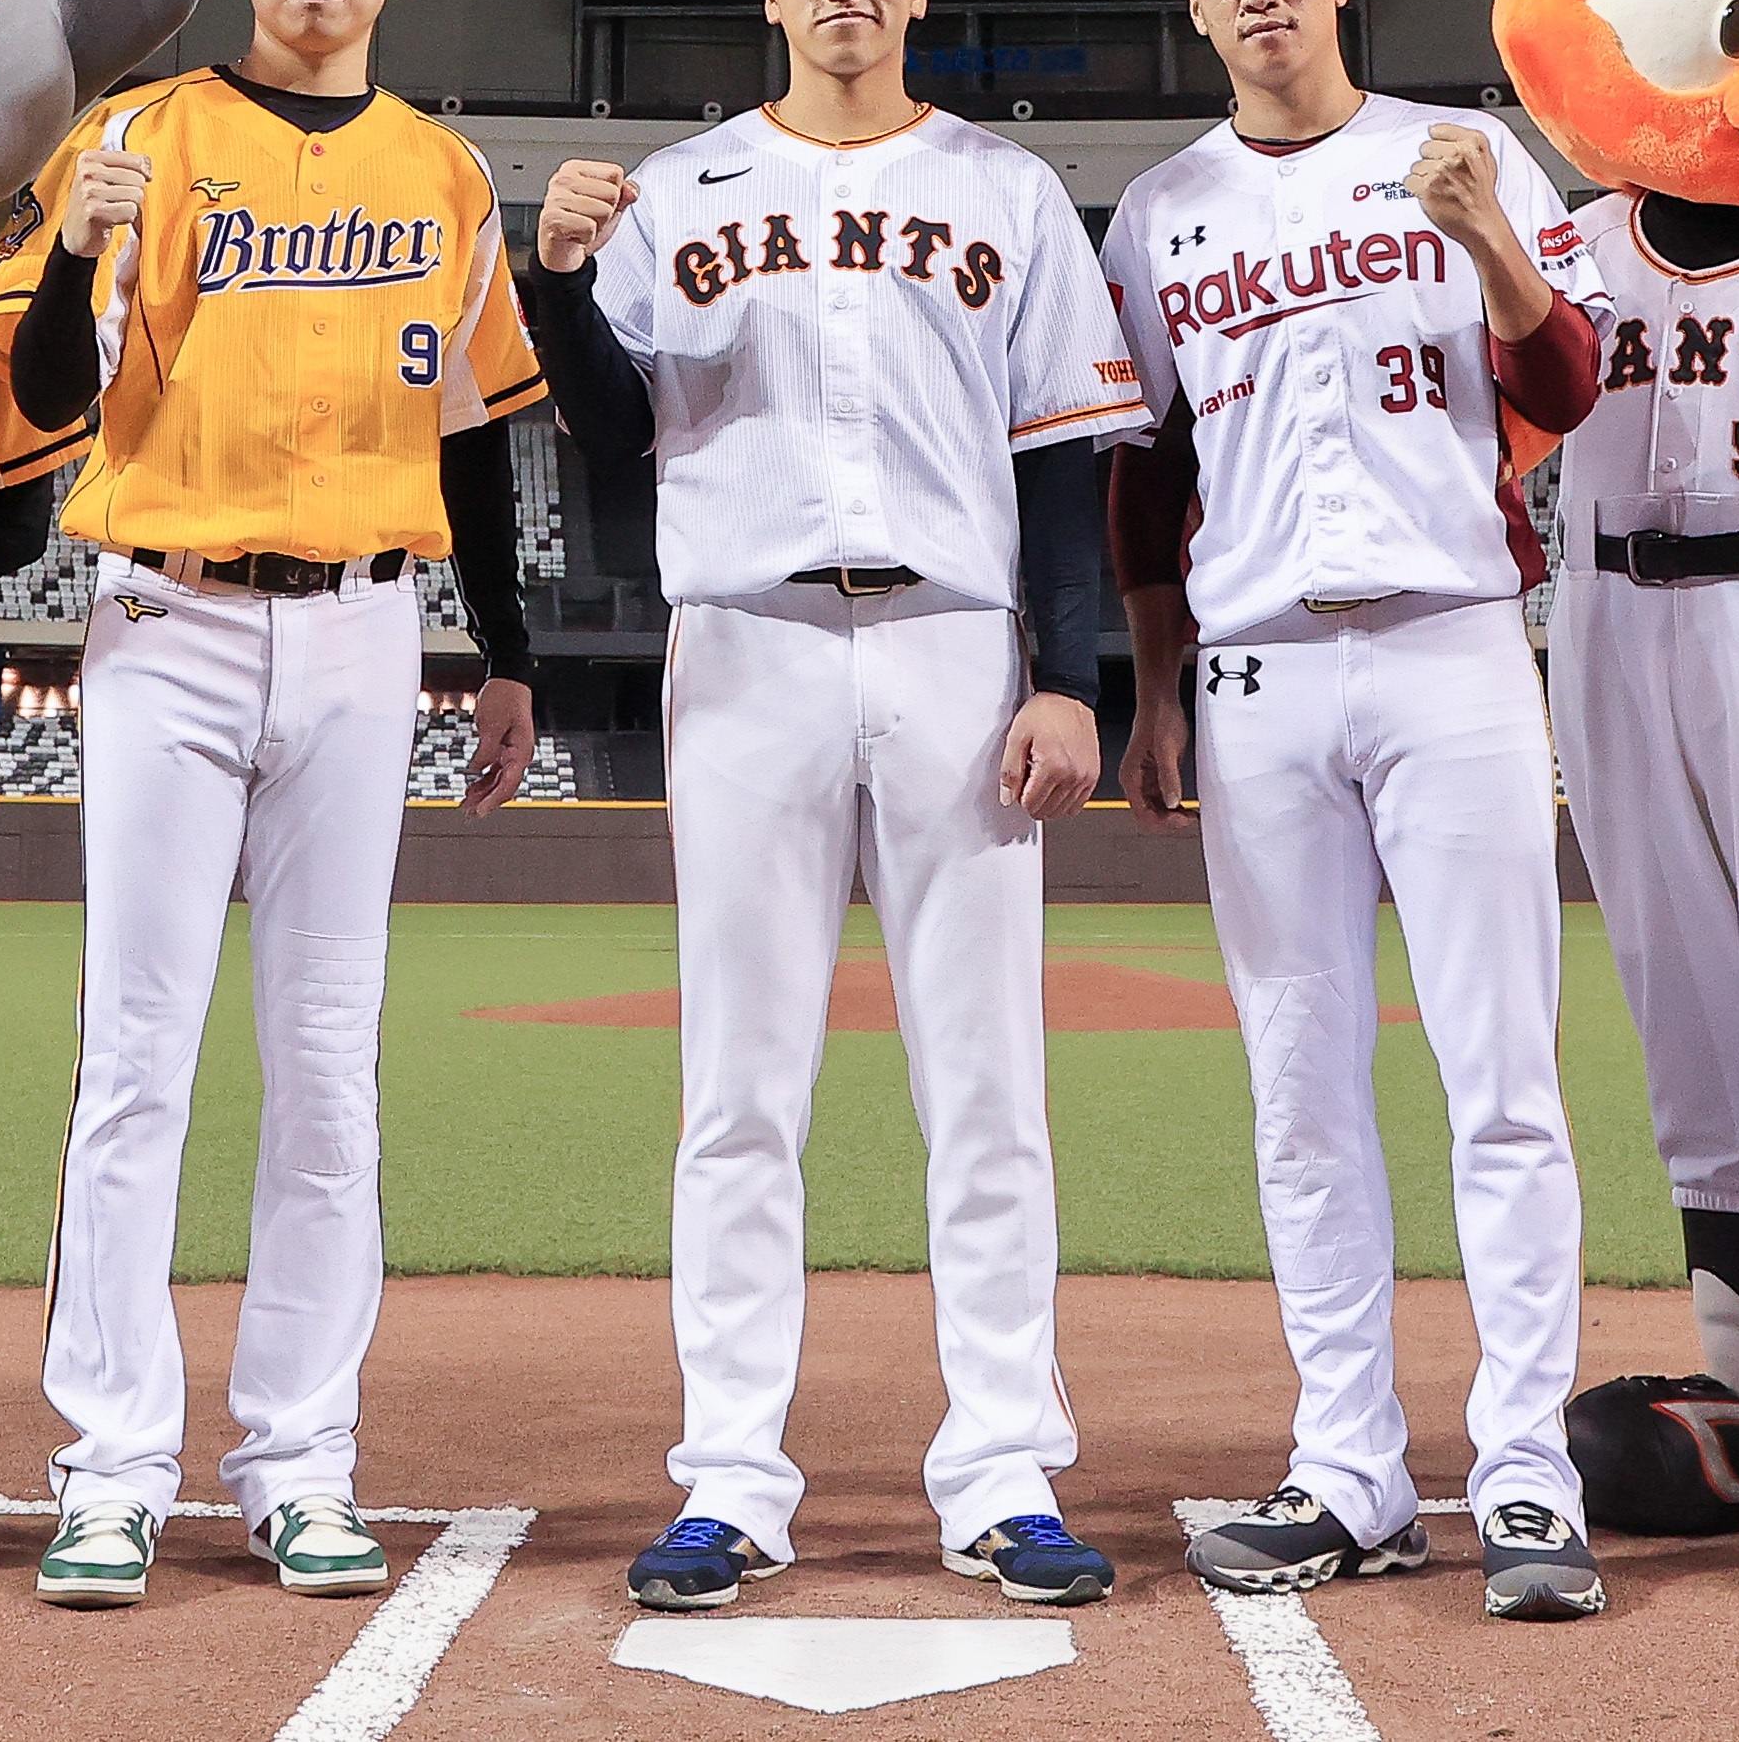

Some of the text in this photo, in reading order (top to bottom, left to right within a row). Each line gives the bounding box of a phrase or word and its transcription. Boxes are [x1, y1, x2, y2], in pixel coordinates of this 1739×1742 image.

[673, 210, 1004, 310] GIANTS
[1158, 229, 1446, 348] Rakuten
[398, 320, 442, 388] 9
[1376, 344, 1448, 414] 39
